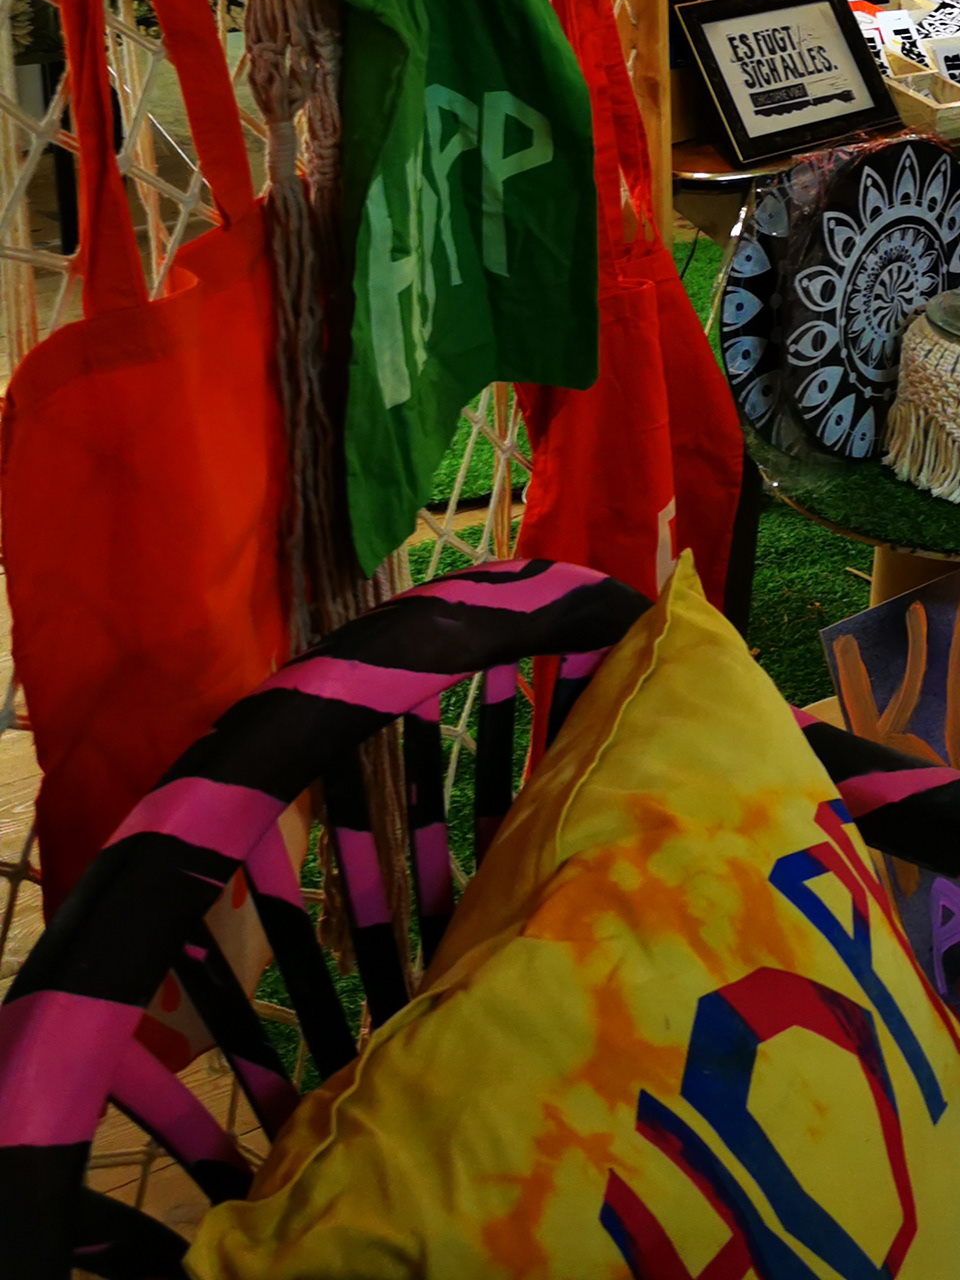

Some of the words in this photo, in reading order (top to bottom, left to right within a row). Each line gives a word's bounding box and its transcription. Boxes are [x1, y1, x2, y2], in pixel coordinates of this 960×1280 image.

[727, 33, 756, 62] ES
[751, 26, 797, 58] FÜGT
[777, 45, 838, 80] ALLES.
